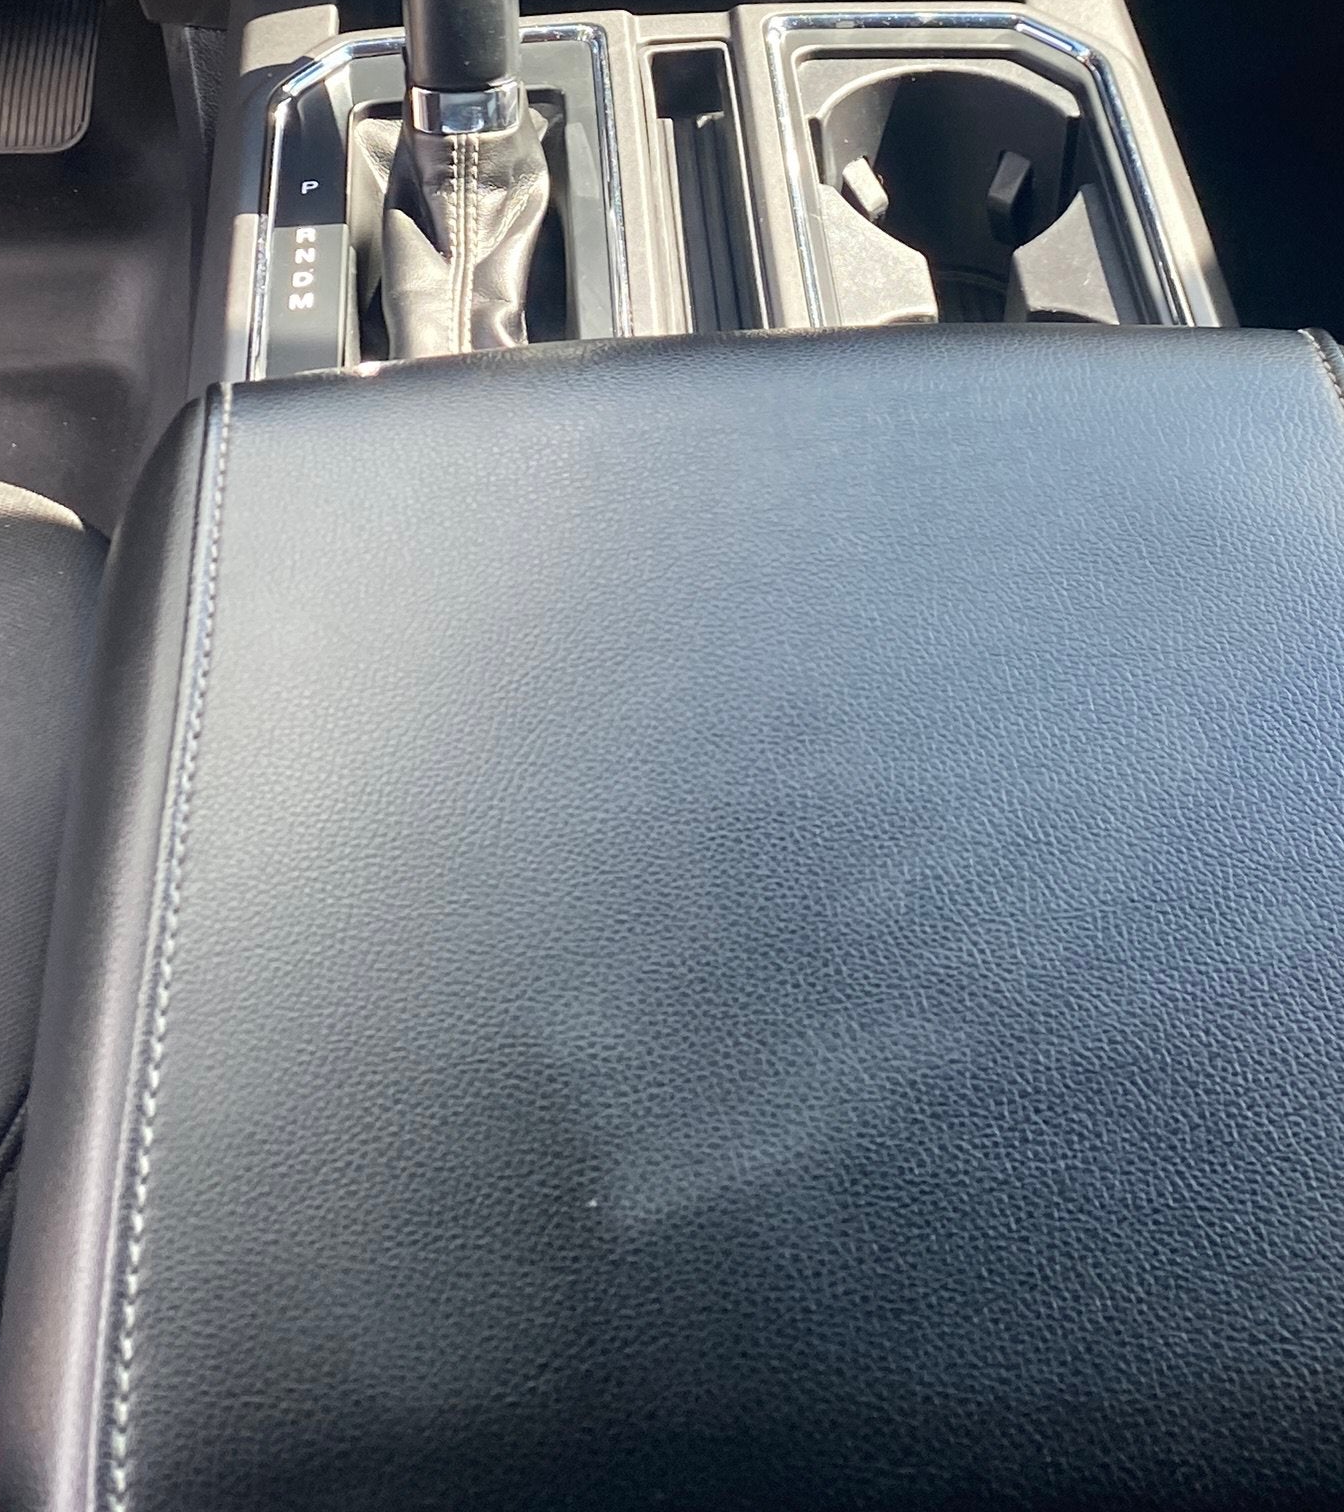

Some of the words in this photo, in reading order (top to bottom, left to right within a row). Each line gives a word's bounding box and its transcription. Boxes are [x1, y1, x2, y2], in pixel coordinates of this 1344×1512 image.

[301, 180, 320, 194] P
[296, 227, 316, 243] R
[294, 248, 316, 264] N
[292, 270, 314, 288] D
[288, 292, 314, 310] M
